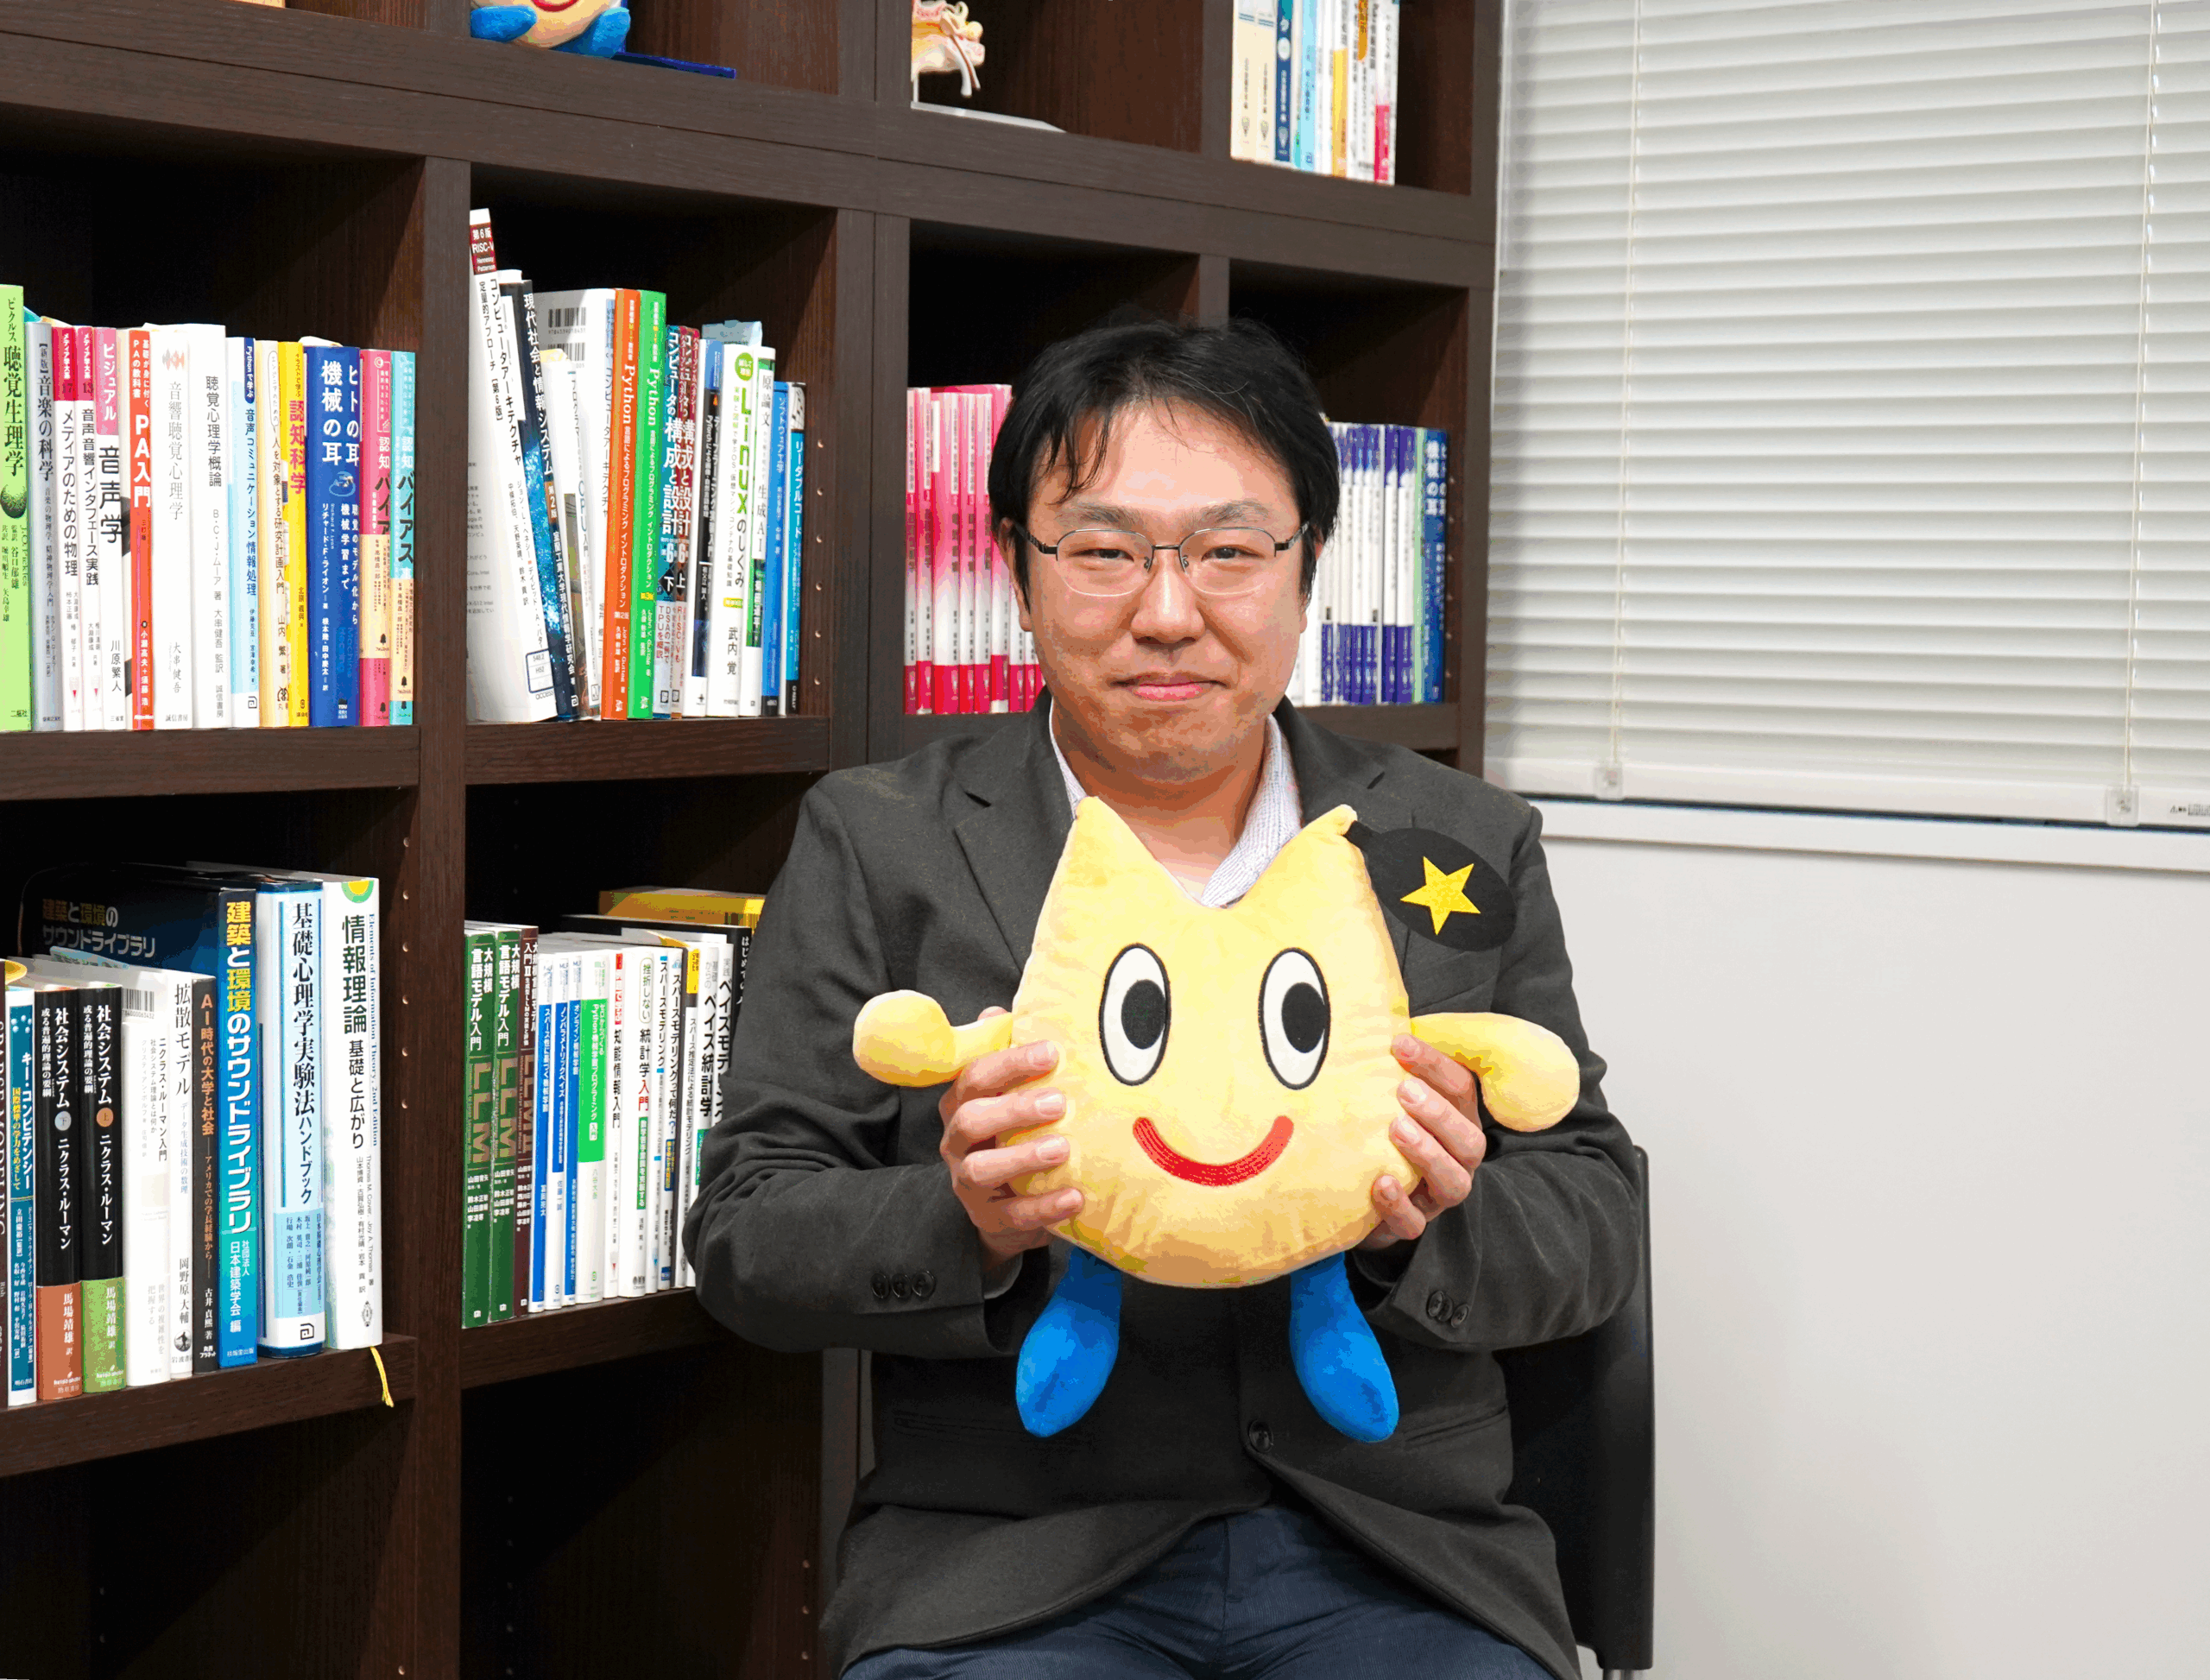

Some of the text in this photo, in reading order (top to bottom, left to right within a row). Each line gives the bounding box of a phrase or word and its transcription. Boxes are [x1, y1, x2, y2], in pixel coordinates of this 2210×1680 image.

[471, 242, 494, 254] RISC-V
[3, 296, 24, 477] ピクルス 聴覚生理学
[132, 339, 142, 399] PAの教科書
[320, 360, 343, 465] 機械の耳
[346, 364, 359, 467] ヒトの耳
[489, 278, 521, 466] コンピュータアーキテクチャ
[523, 293, 553, 476] 現代社会と情報システム
[38, 376, 54, 483] 音楽の科学
[98, 344, 122, 544] ビジュアル 音声学
[133, 414, 151, 508] PA入門
[168, 382, 184, 520] 音響聴覚心理学
[205, 376, 222, 487] 聴覚心理学概論
[289, 400, 306, 495] 認知科学
[661, 332, 683, 536] コンピュータの構成と設計
[61, 409, 78, 577] メディアのための物理
[82, 408, 98, 586] 音声音響インタフェース実践
[245, 408, 257, 596] 音声コミュニケーション情報処理
[272, 437, 286, 595] 人を対象とする研究計画入門
[735, 387, 751, 588] Linuxのしくみ
[341, 503, 350, 590] 機械学習まで
[110, 640, 122, 692] 川原繁人
[214, 609, 224, 648] 大串健吾
[727, 627, 737, 675] 武内 覚
[42, 898, 118, 927] 建築と環境の
[43, 925, 155, 958] サウンドライブラリ
[369, 963, 376, 974] of
[470, 948, 483, 1051] 言語モデル入門
[483, 948, 494, 993] 大規模
[498, 944, 510, 1047] 言語モデル入門
[511, 944, 521, 990] 大規模
[642, 963, 651, 1020] 挫折しない
[657, 962, 668, 1067] スパースモデリング
[704, 961, 713, 990] からの
[54, 1007, 71, 1108] 社会システム
[97, 1004, 112, 1104] 社会システム
[174, 982, 191, 1096] 拡散モデル
[226, 901, 252, 1234] 建築と環境のサウンドライブラリ
[293, 902, 315, 1204] 基礎心理学実験法ハンドブック
[342, 914, 367, 1149] 情報理論 基礎と広がり
[542, 1008, 552, 1113] スパース性に基づく機械学習
[558, 1006, 567, 1098] ノンパラメトリックベイズ
[572, 1004, 581, 1076] オンライン機械学習
[638, 1028, 651, 1111] 統計学入門
[699, 994, 717, 1117] ベイズ統計学
[22, 1052, 33, 1189] キー・コンピテンシー
[159, 1038, 167, 1162] ニクラス・ルーマン入門
[180, 1102, 188, 1194] データ生成技術の数理
[200, 995, 216, 1260] AI時代の大学と社会 アメリカでの学長経験から
[472, 1062, 491, 1163] LLM
[499, 1058, 518, 1158] LLM
[58, 1137, 72, 1250] ニクラス・ルーマン
[99, 1134, 113, 1245] ニクラス・ルーマン
[180, 1257, 189, 1324] 岡野原 大輔
[205, 1287, 213, 1306] 古井
[230, 1241, 242, 1333] 日本建築学会 編
[242, 1240, 250, 1277] 社団法人
[63, 1292, 75, 1344] 馬場靖雄
[106, 1286, 117, 1337] 馬場靖雄
[205, 1330, 213, 1340] 著
